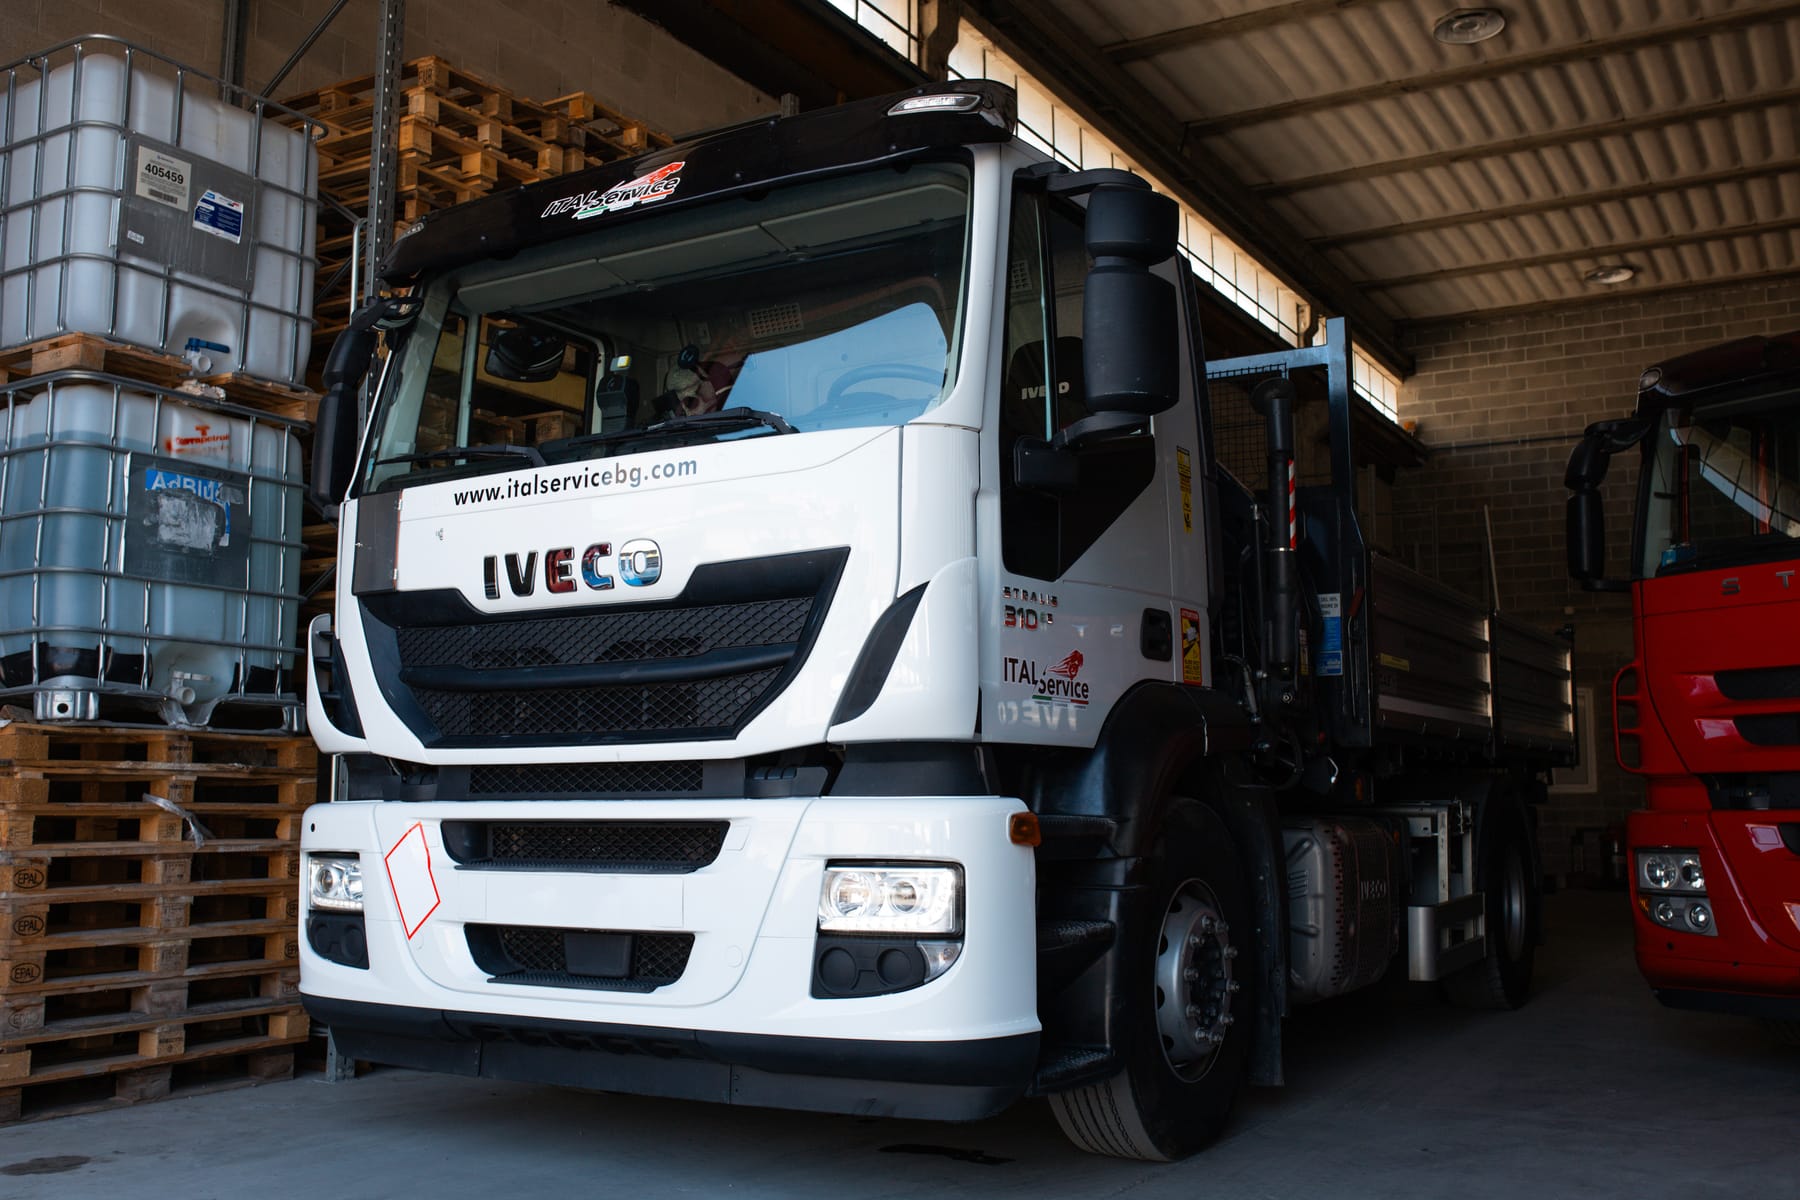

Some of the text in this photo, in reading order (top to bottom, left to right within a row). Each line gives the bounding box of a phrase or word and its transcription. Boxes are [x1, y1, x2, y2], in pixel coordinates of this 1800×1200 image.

[144, 163, 184, 185] 405459
[1021, 381, 1070, 400] IVEO
[453, 459, 698, 506] www.italservicebg.com
[483, 538, 663, 600] IVECO
[1003, 586, 1058, 607] STRALIS
[1004, 604, 1038, 631] 310
[17, 870, 40, 885] EPAL
[17, 918, 40, 932] EPAL
[14, 967, 37, 979] EPAL
